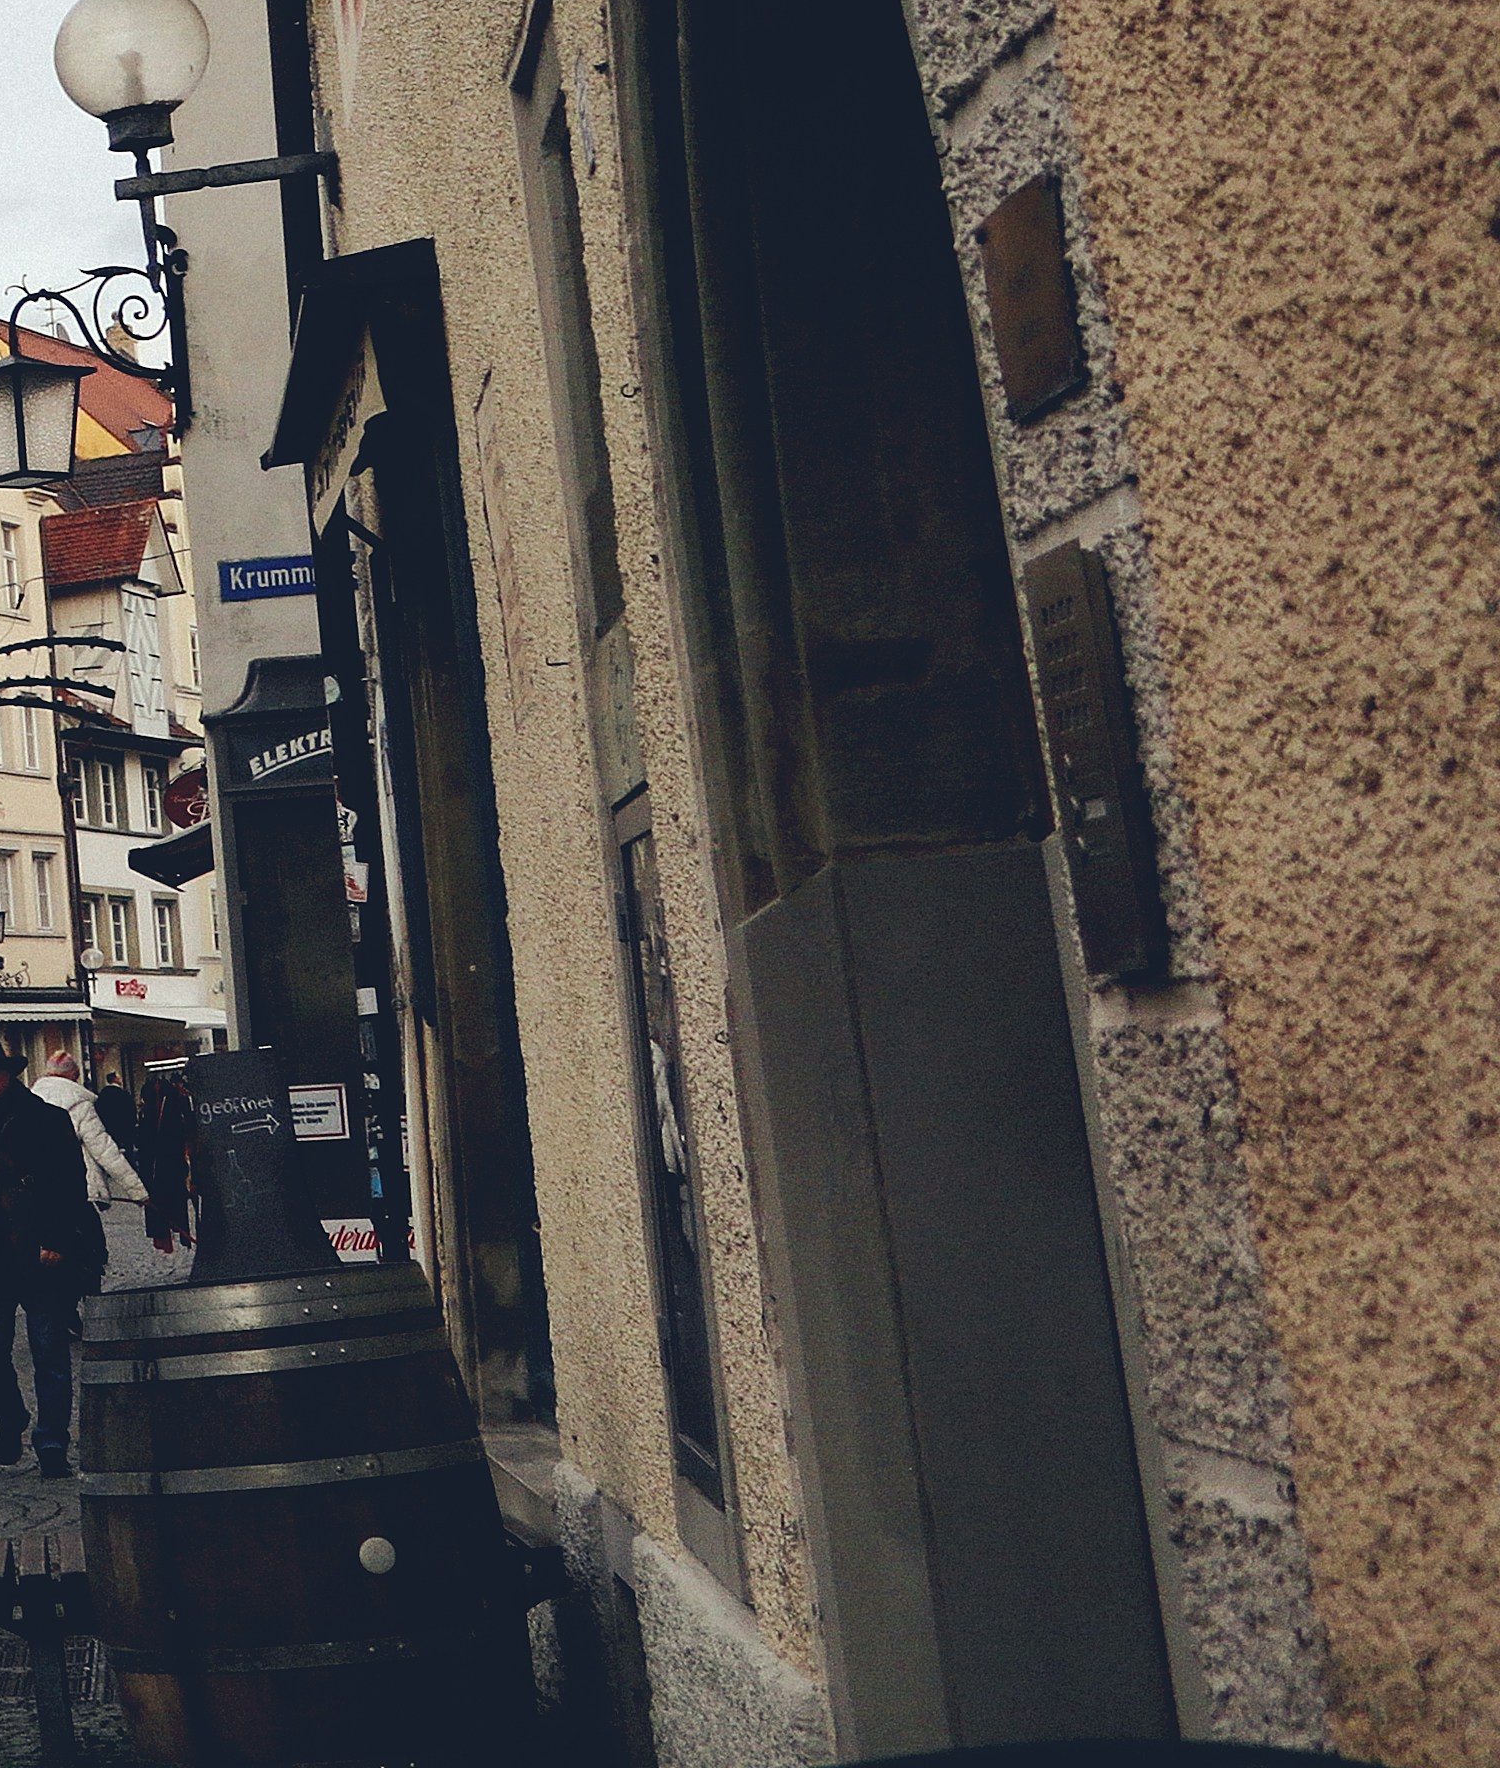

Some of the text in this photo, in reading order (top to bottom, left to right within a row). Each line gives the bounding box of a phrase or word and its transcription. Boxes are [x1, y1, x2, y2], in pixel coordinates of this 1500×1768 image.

[230, 565, 315, 590] Krumm
[250, 729, 332, 777] ELEKTR
[200, 1094, 275, 1124] geöffnet
